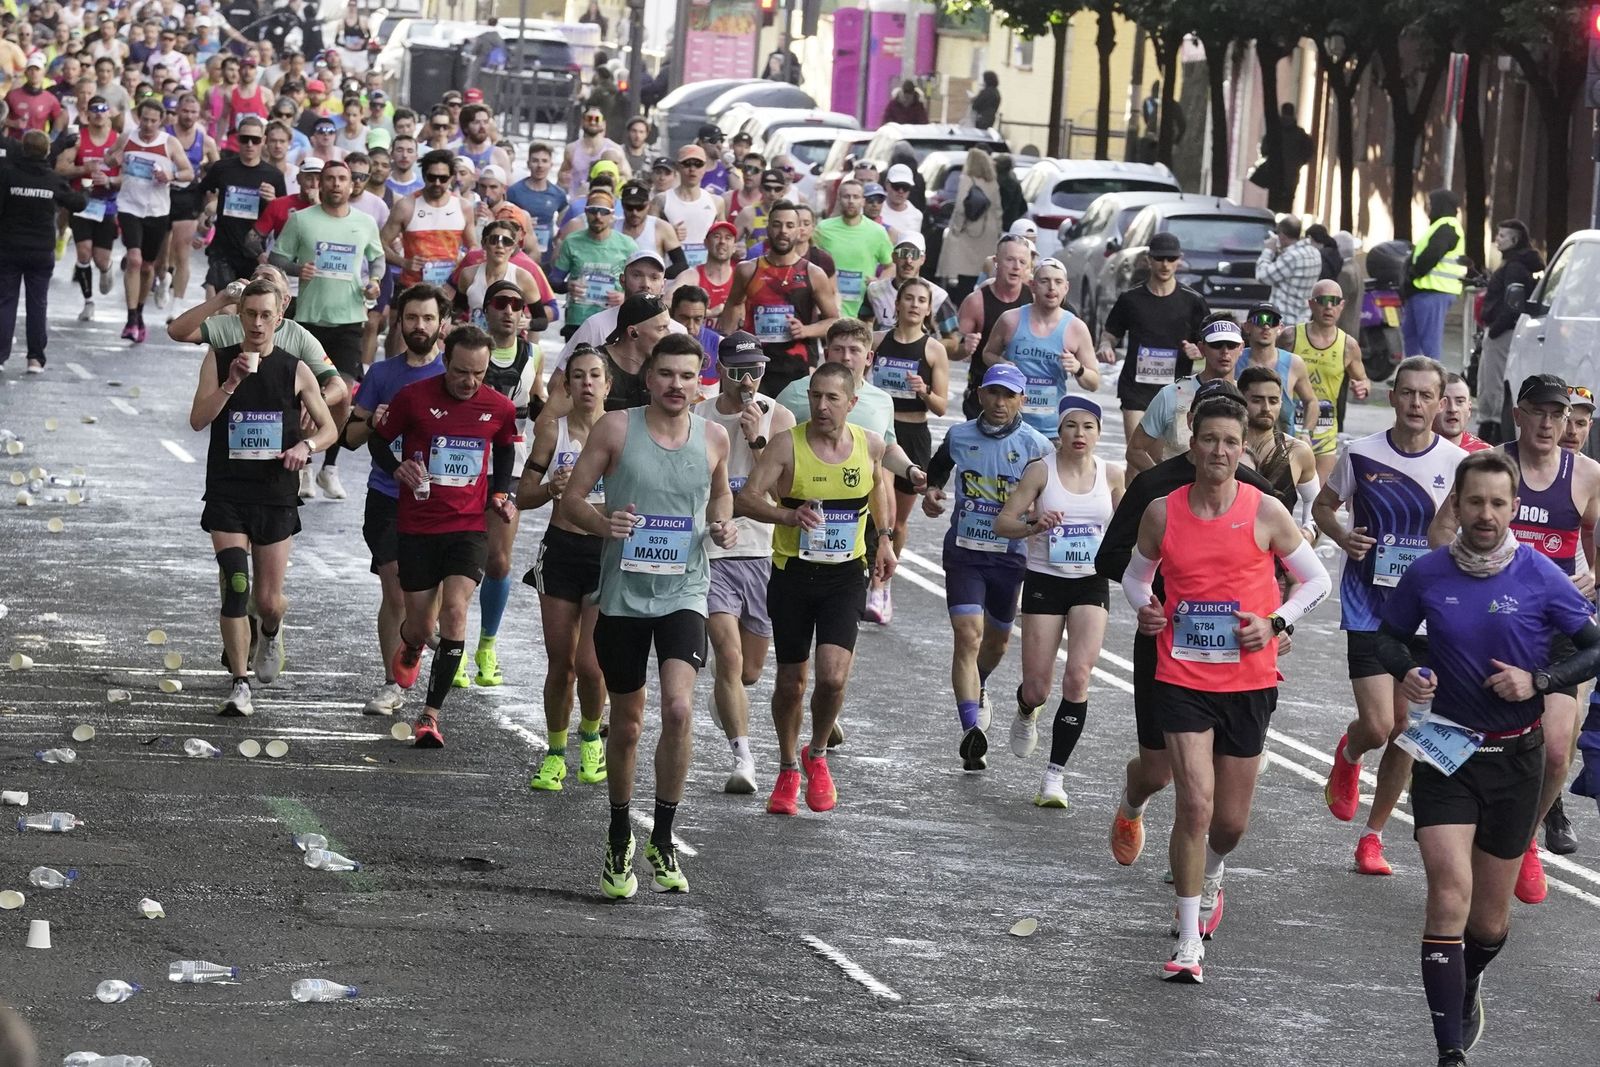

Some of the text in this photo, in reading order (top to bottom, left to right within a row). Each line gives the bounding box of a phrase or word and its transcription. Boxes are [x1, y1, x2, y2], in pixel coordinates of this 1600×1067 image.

[10, 187, 54, 199] VOLUNTEER
[322, 263, 347, 271] JULIEN
[888, 359, 914, 369] ZURICH
[1137, 367, 1174, 377] LACOLOCO
[882, 379, 906, 389] EMMA
[1028, 377, 1053, 385] ZURICH
[240, 437, 270, 448] KEVIN
[449, 439, 479, 448] ZURICH
[444, 463, 469, 475] YAYO
[976, 504, 1002, 514] ZURIC
[1519, 504, 1549, 523] ROB
[824, 513, 854, 521] ZURICH
[649, 519, 686, 528] ZURICH
[966, 527, 999, 541] MARC
[1067, 527, 1097, 535] ZURICH
[648, 535, 668, 545] 9376
[634, 546, 678, 561] MAXOU
[1065, 550, 1091, 562] MILA
[1193, 604, 1232, 613] ZURICH
[1194, 622, 1215, 631] 6784
[1186, 633, 1226, 647] PABLO
